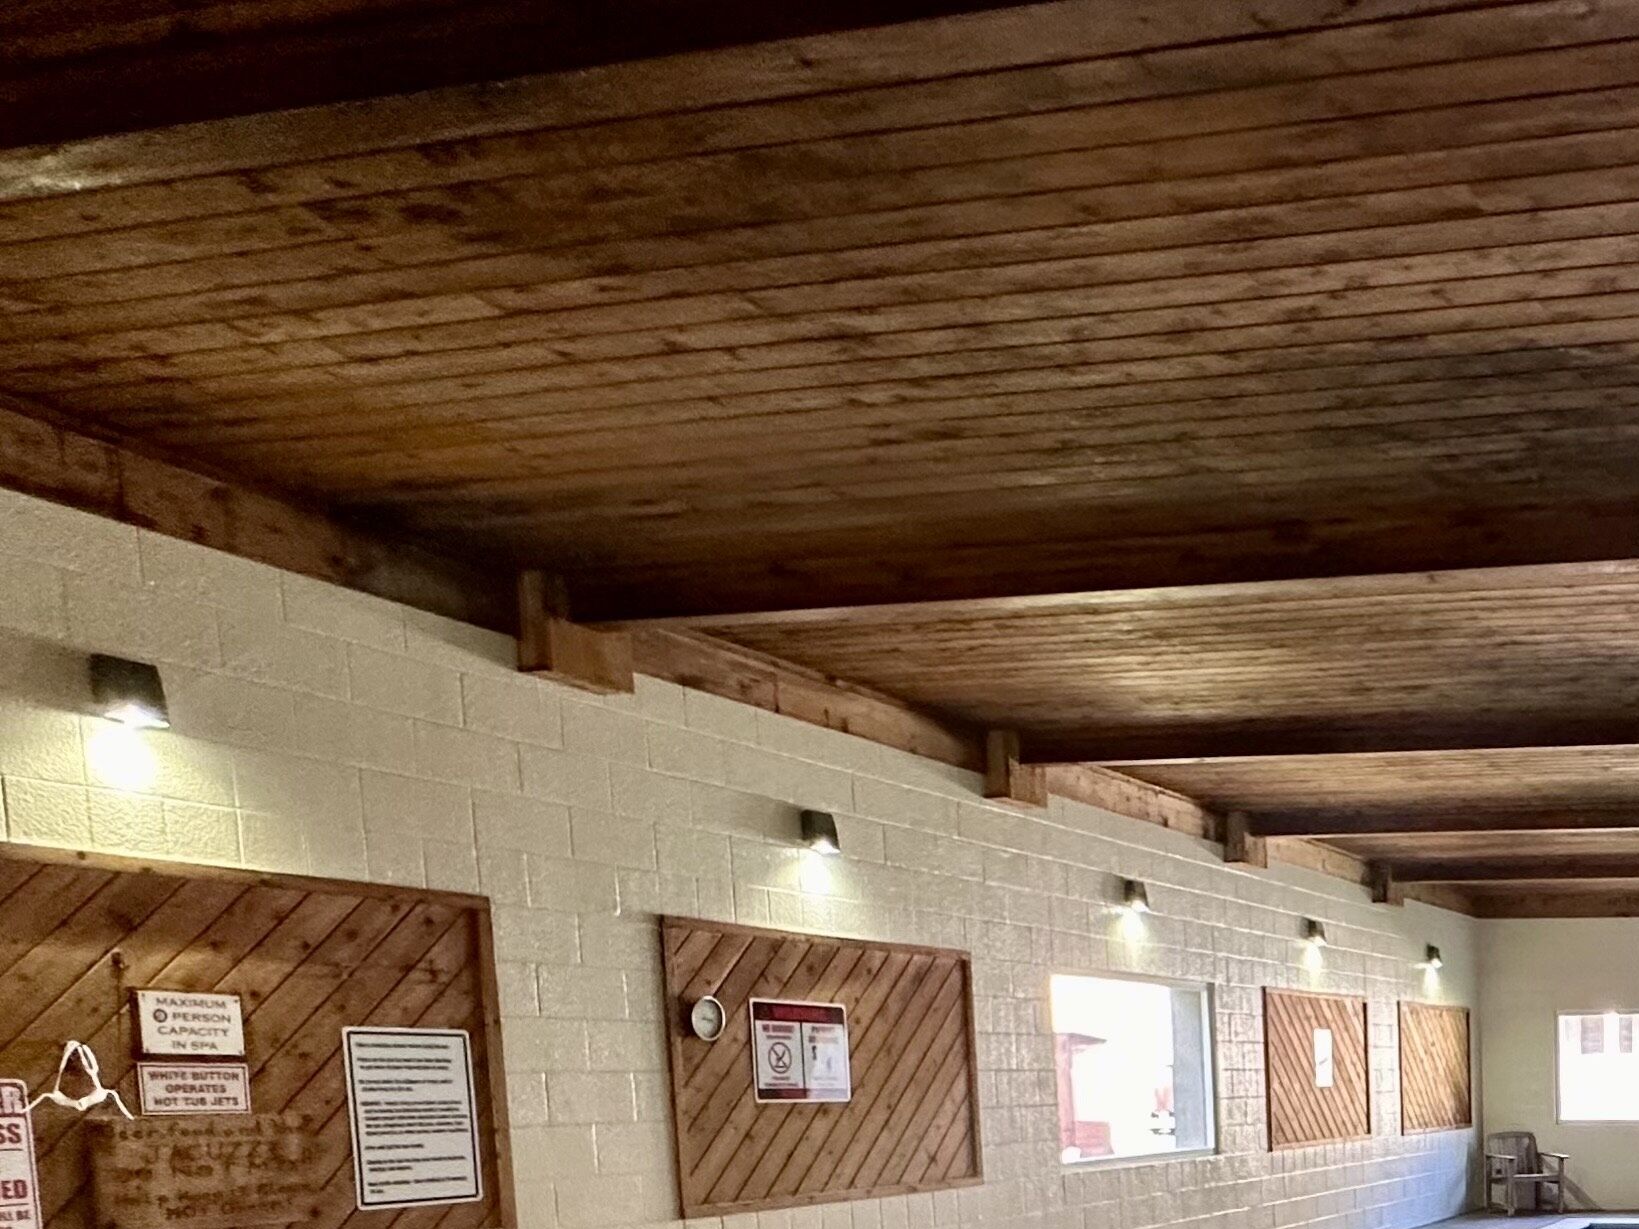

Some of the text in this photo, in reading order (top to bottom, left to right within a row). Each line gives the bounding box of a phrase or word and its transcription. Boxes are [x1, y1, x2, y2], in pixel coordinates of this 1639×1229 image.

[155, 998, 227, 1009] MAXIMUM
[172, 1012, 232, 1023] PERSON
[157, 1026, 229, 1037] CAPACITY
[171, 1041, 219, 1051] IN SPA
[148, 1071, 240, 1081] WHITE BUTTON
[165, 1084, 227, 1094] OPERATES
[154, 1096, 240, 1107] HOT TUB JETS
